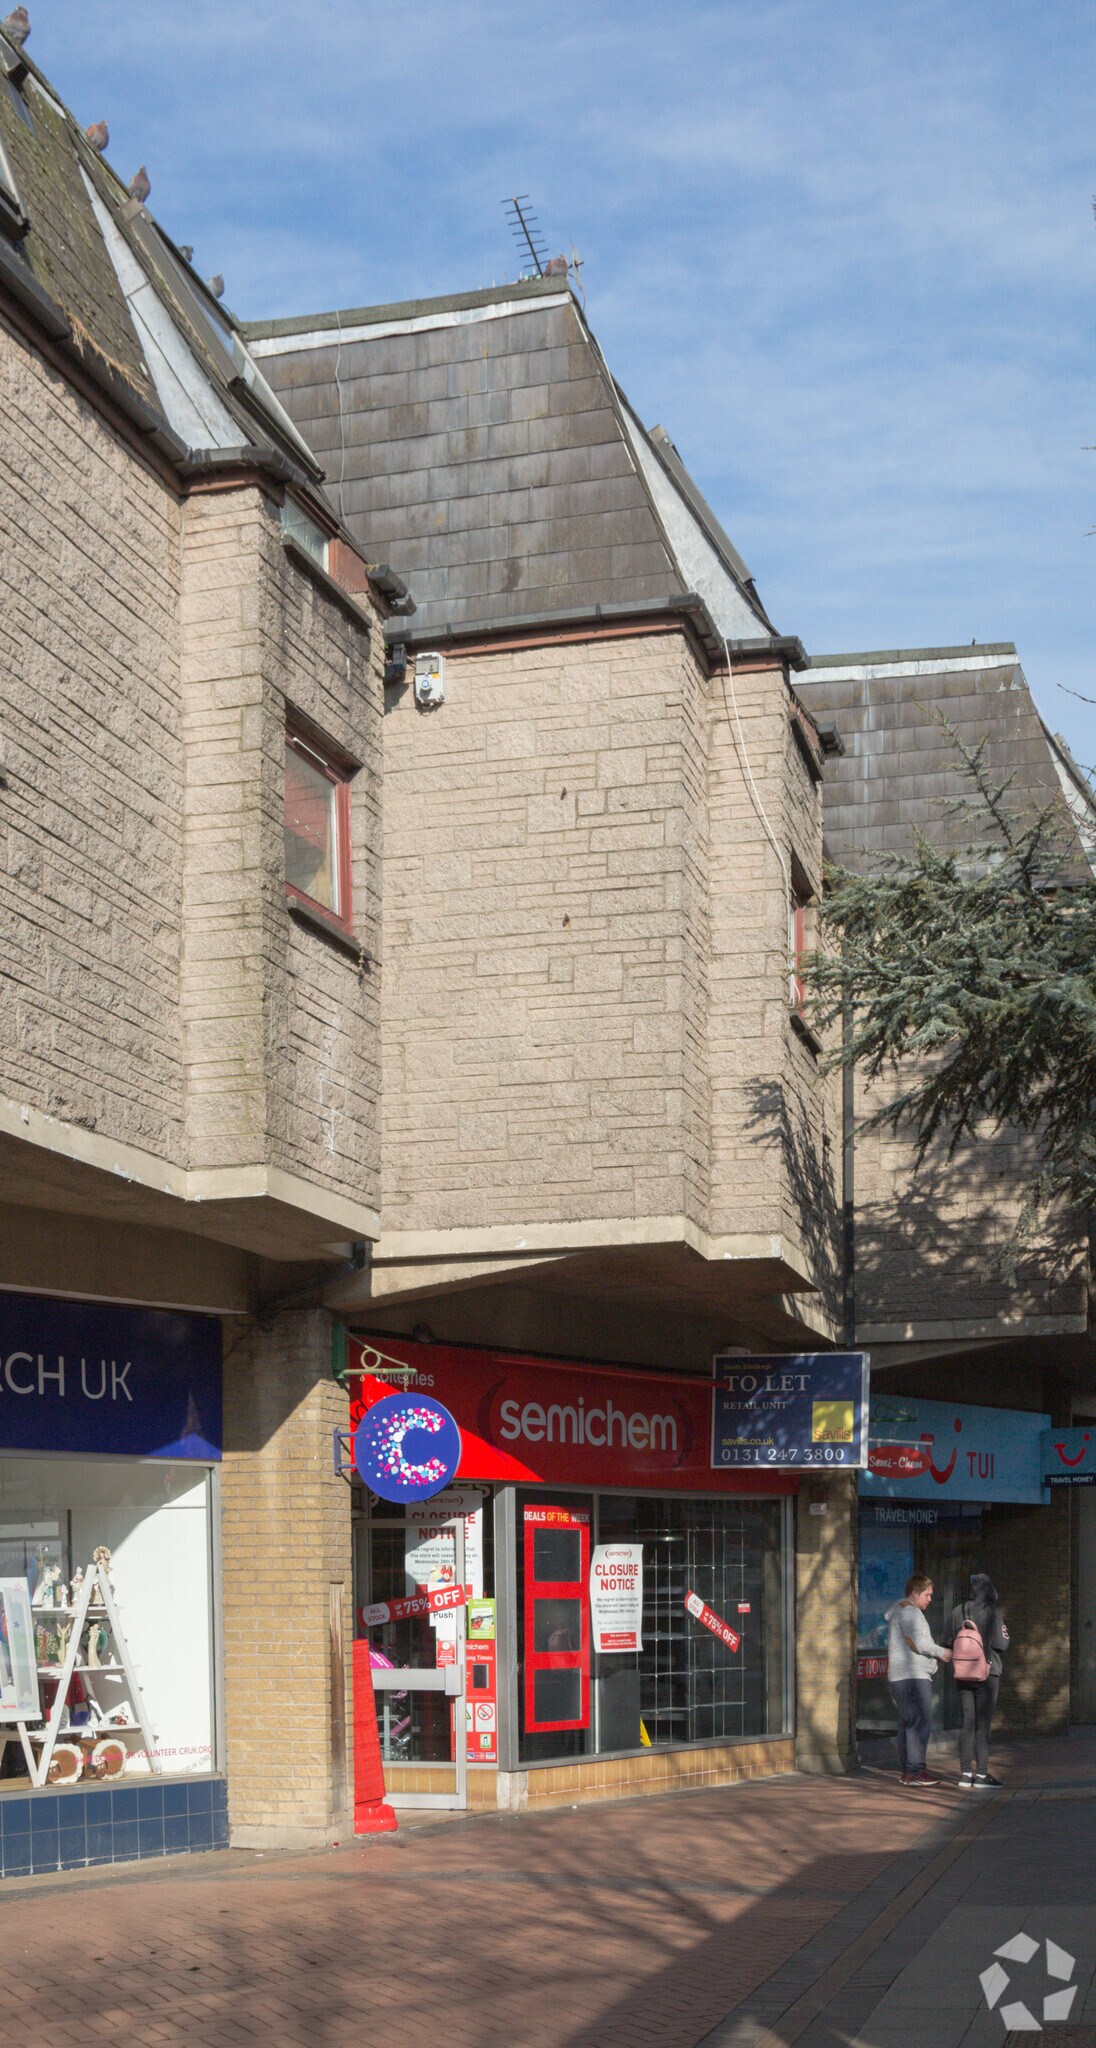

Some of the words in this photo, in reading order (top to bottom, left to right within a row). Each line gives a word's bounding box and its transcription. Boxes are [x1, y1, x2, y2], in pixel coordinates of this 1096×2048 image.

[0, 1352, 65, 1397] CH
[81, 1358, 133, 1401] UK
[723, 1375, 758, 1392] TO
[764, 1375, 811, 1391] LET
[723, 1402, 760, 1410] RETAIL
[762, 1402, 788, 1410] UNIT
[500, 1396, 677, 1451] semichem
[814, 1427, 851, 1440] savills
[722, 1437, 775, 1446] savills.co.uk
[722, 1449, 760, 1461] 0131
[768, 1449, 798, 1461] 247
[804, 1449, 845, 1461] 3800
[868, 1456, 923, 1469] Semi-Chem
[966, 1451, 994, 1479] TUI
[524, 1511, 546, 1521] DEALS
[547, 1512, 556, 1521] OF
[557, 1513, 569, 1522] THE
[571, 1513, 590, 1523] WEEK
[874, 1507, 908, 1523] TRAVEL
[908, 1509, 939, 1524] MONEY
[595, 1564, 639, 1576] CLOSURE
[600, 1578, 635, 1590] NOTICE
[403, 1597, 431, 1614] 75%
[434, 1590, 460, 1606] OFF
[433, 1611, 453, 1619] Push
[707, 1614, 723, 1635] 75%
[722, 1628, 738, 1646] OFF
[865, 1659, 887, 1676] NOW
